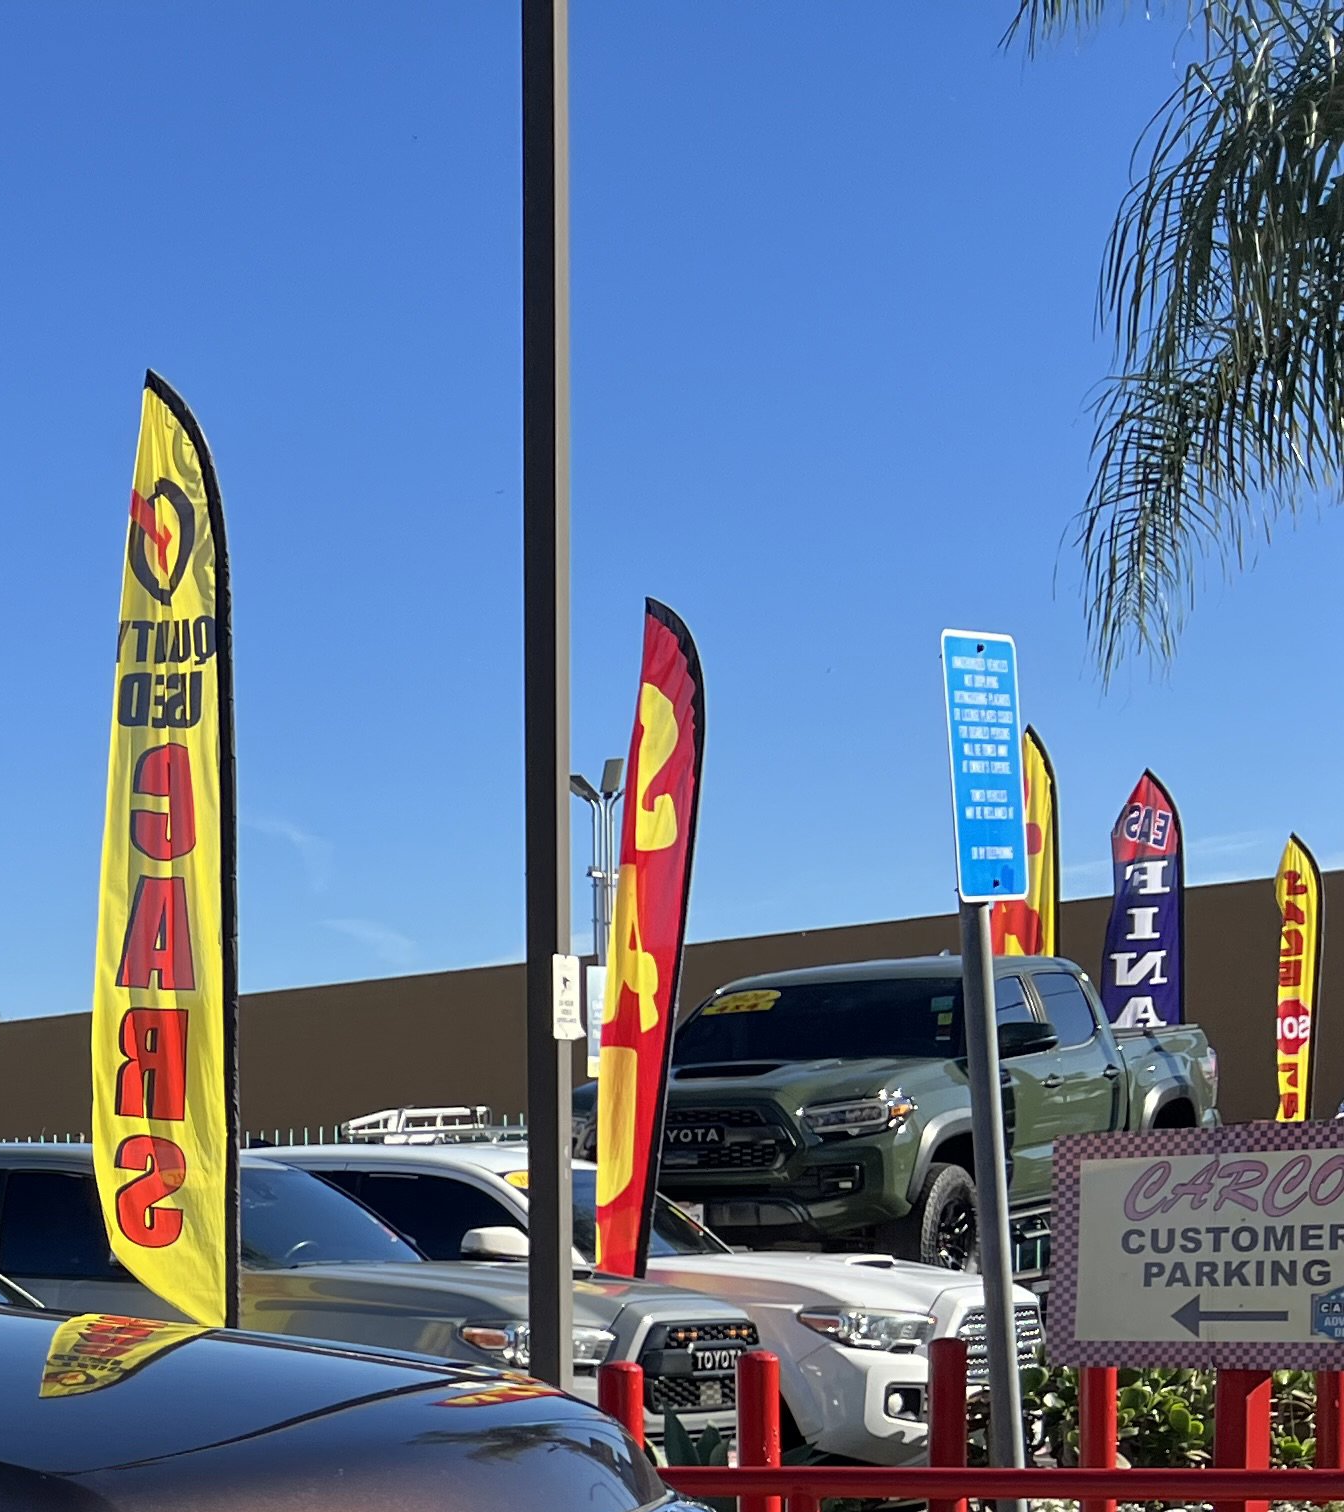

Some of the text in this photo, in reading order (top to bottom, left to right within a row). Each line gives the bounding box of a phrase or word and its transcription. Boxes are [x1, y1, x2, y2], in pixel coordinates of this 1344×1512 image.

[666, 1127, 720, 1143] YOTA
[1124, 1154, 1344, 1222] CARCO
[1143, 1259, 1332, 1288] PARKING
[695, 1349, 742, 1370] TOYOT
